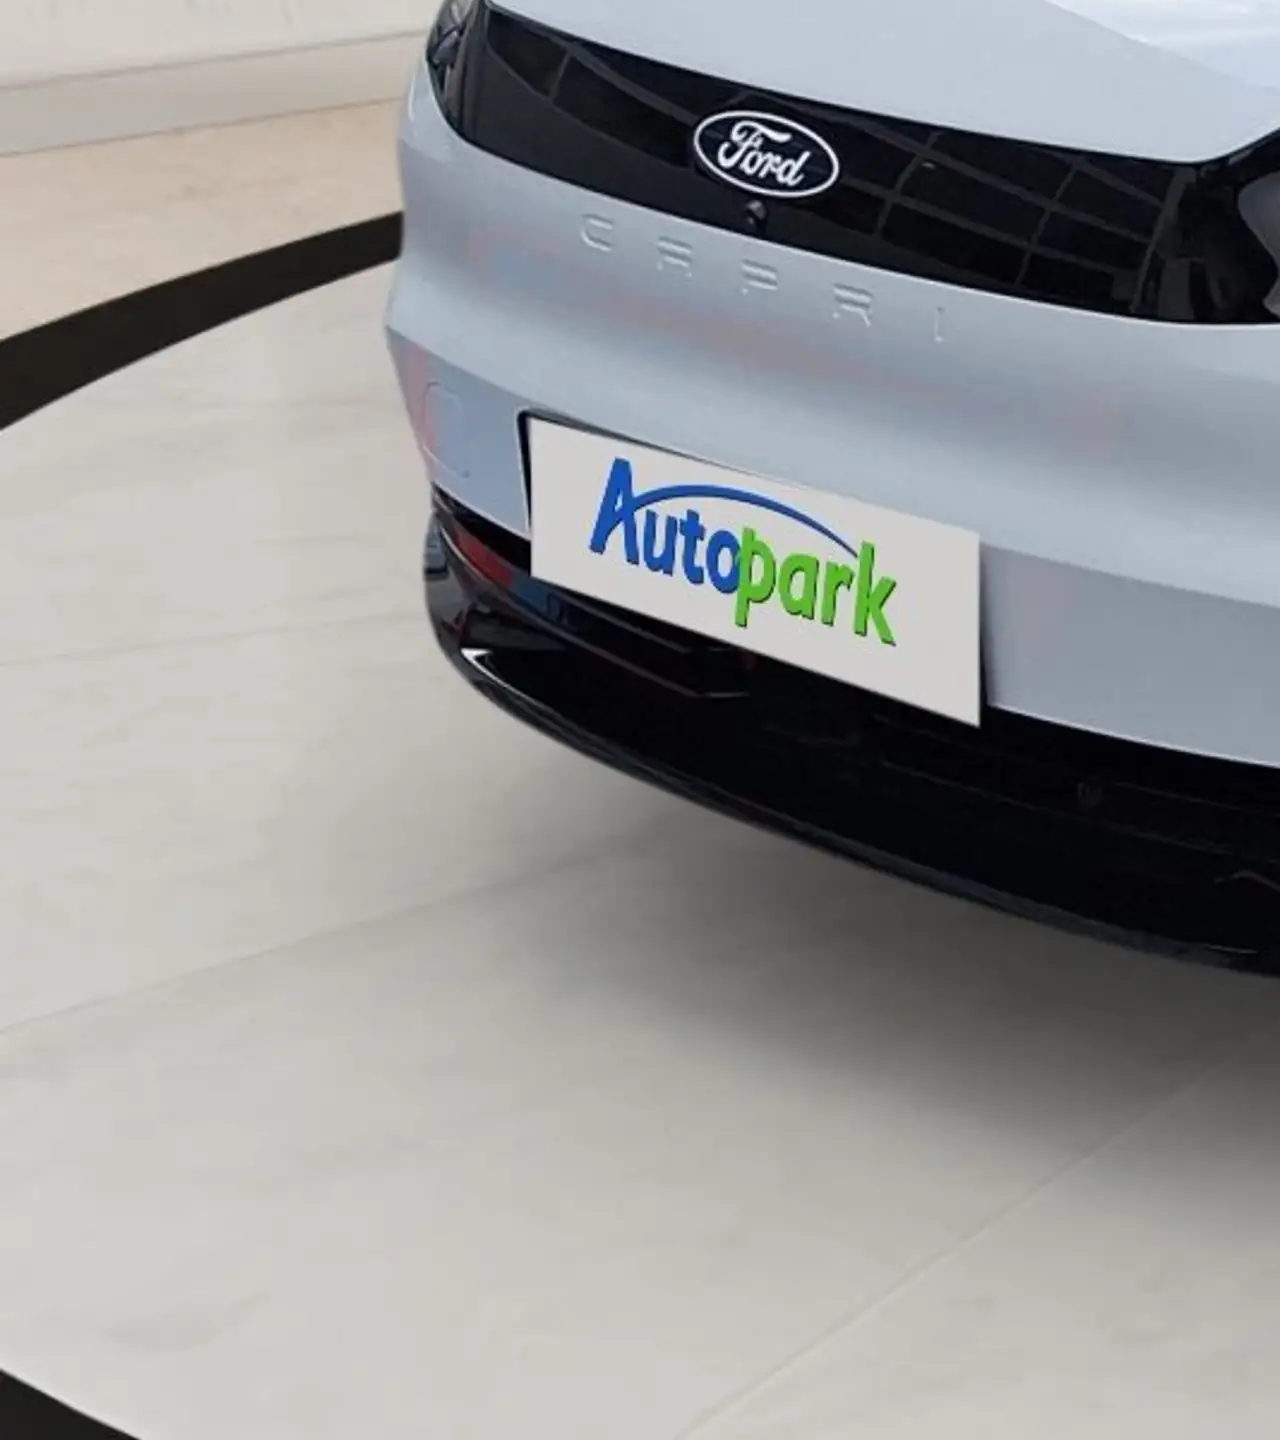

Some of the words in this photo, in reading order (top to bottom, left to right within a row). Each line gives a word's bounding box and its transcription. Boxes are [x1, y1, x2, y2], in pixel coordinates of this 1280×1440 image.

[717, 119, 811, 187] Ford
[579, 212, 944, 343] CAPRI
[589, 457, 897, 647] Autopark
